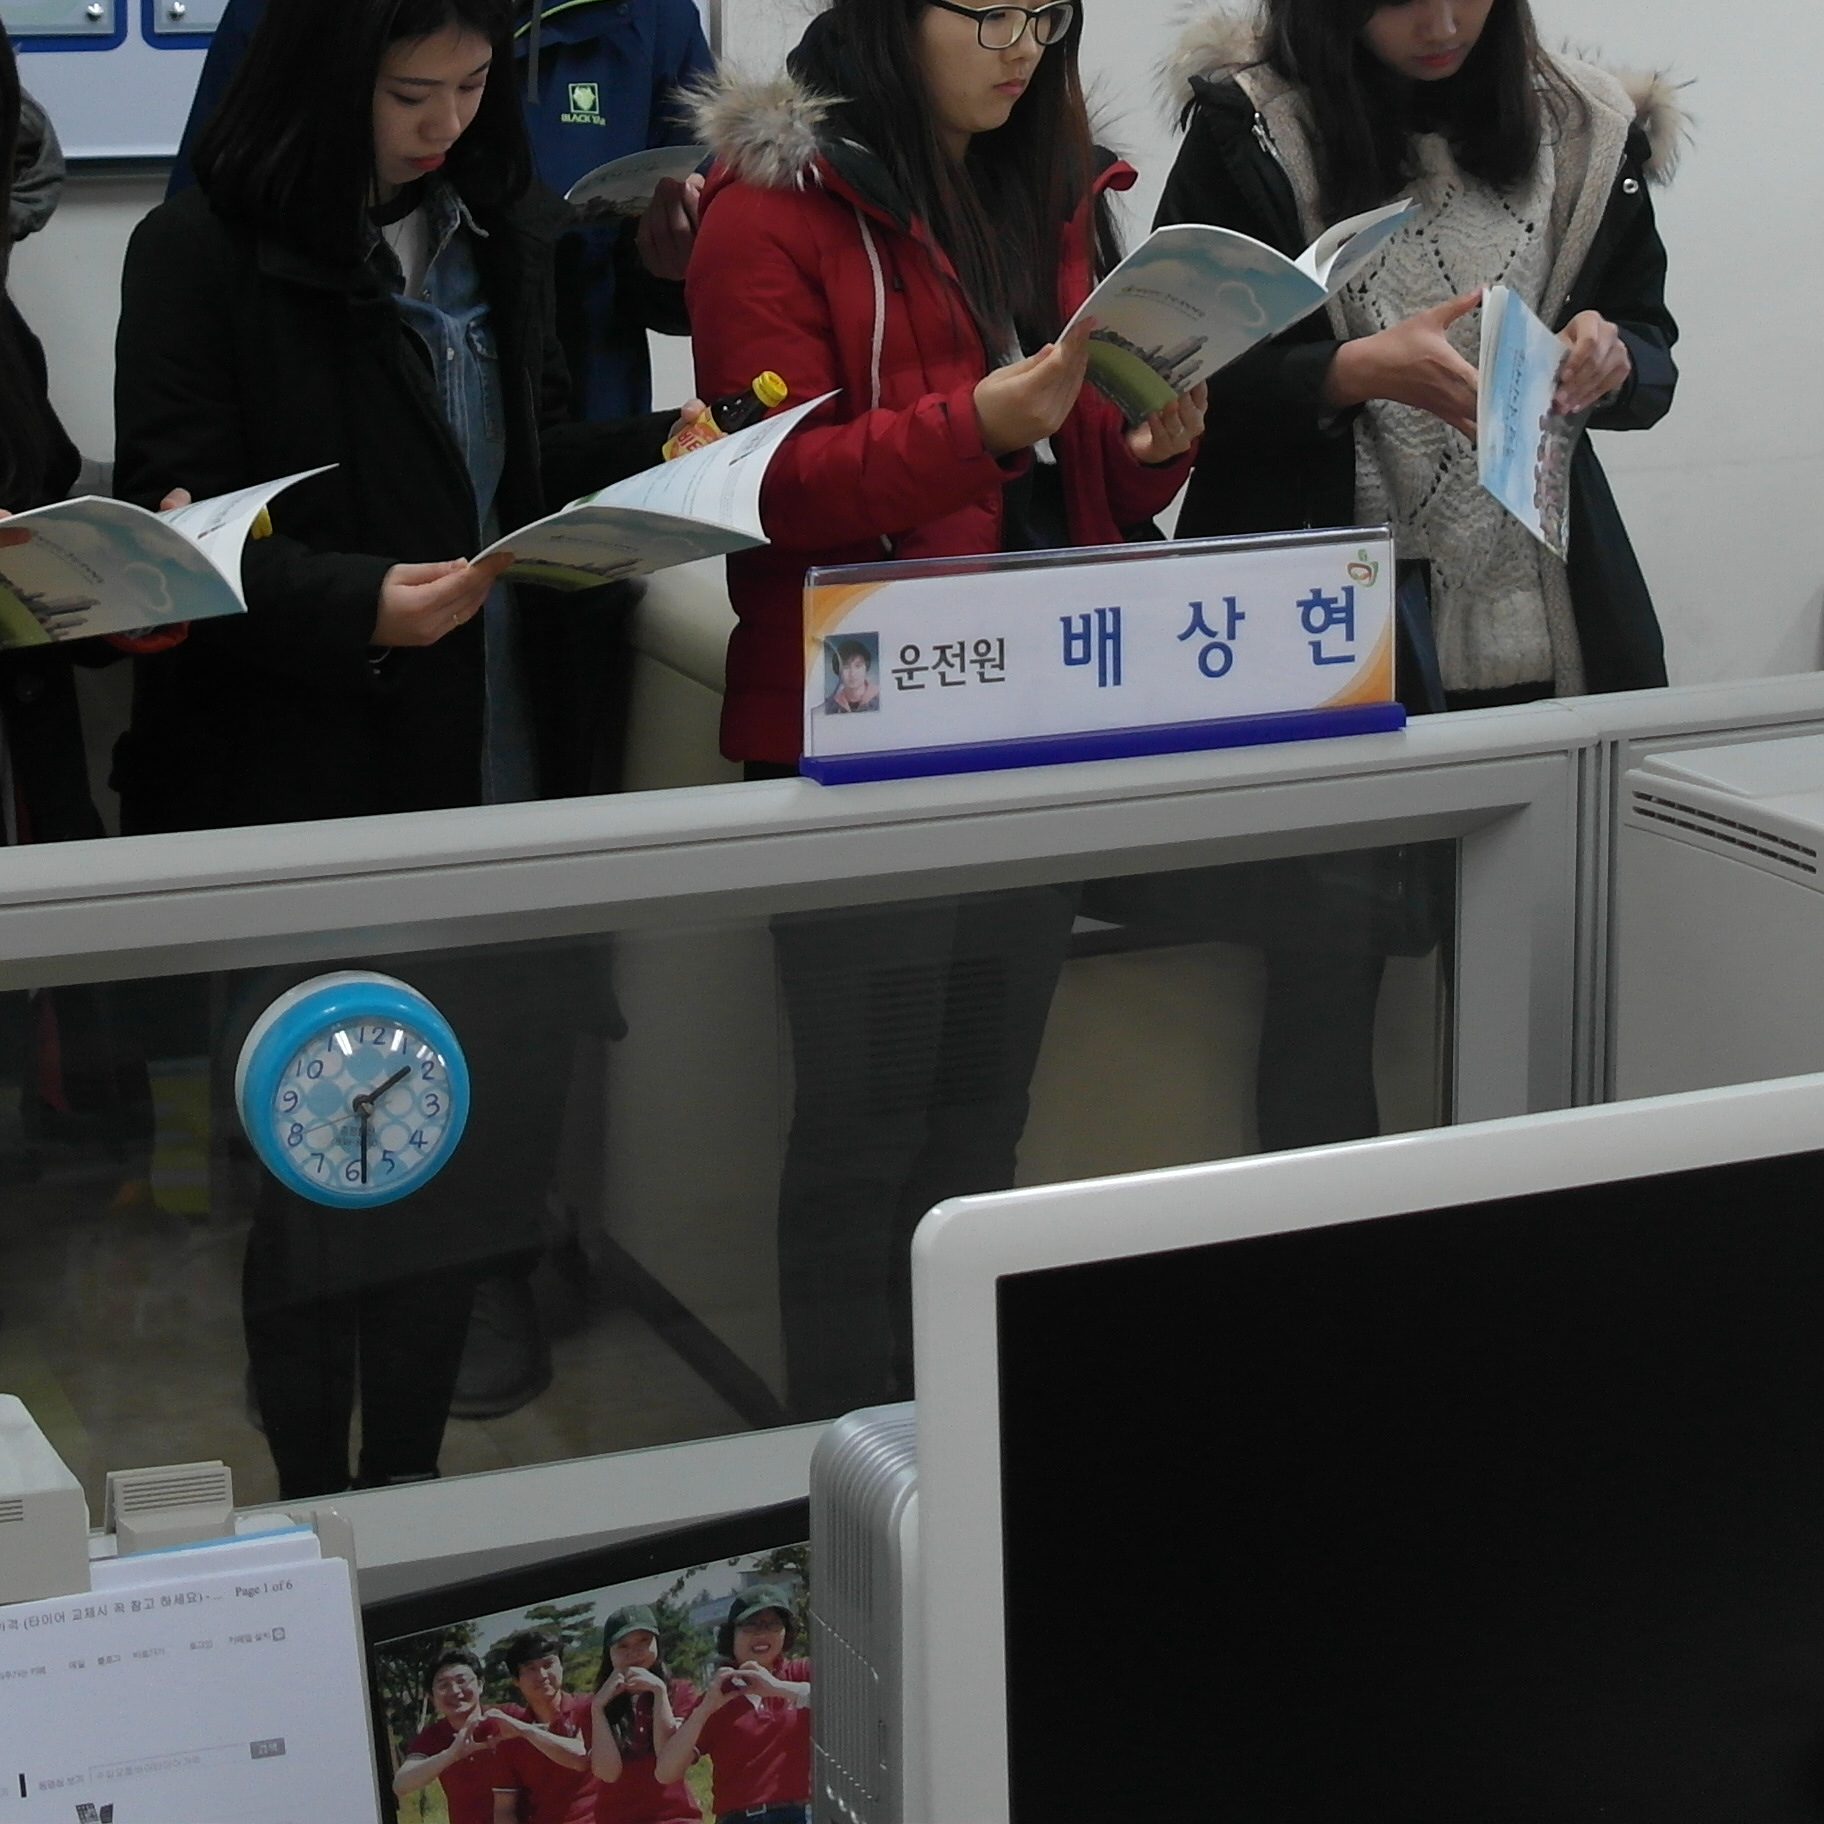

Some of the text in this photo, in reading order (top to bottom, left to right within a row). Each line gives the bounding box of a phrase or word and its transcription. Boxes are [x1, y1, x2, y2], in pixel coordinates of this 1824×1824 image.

[890, 636, 1007, 692] 운전원
[359, 1027, 385, 1045] 12
[295, 1056, 324, 1079] 10
[421, 1061, 435, 1080] 2
[282, 1090, 299, 1113] 9
[425, 1094, 440, 1118] 3
[287, 1123, 303, 1146] 8
[409, 1130, 428, 1148] 4
[310, 1153, 325, 1173] 7
[345, 1159, 360, 1181] 6
[381, 1150, 395, 1174] 5
[234, 1580, 294, 1598] Page 1 of 6
